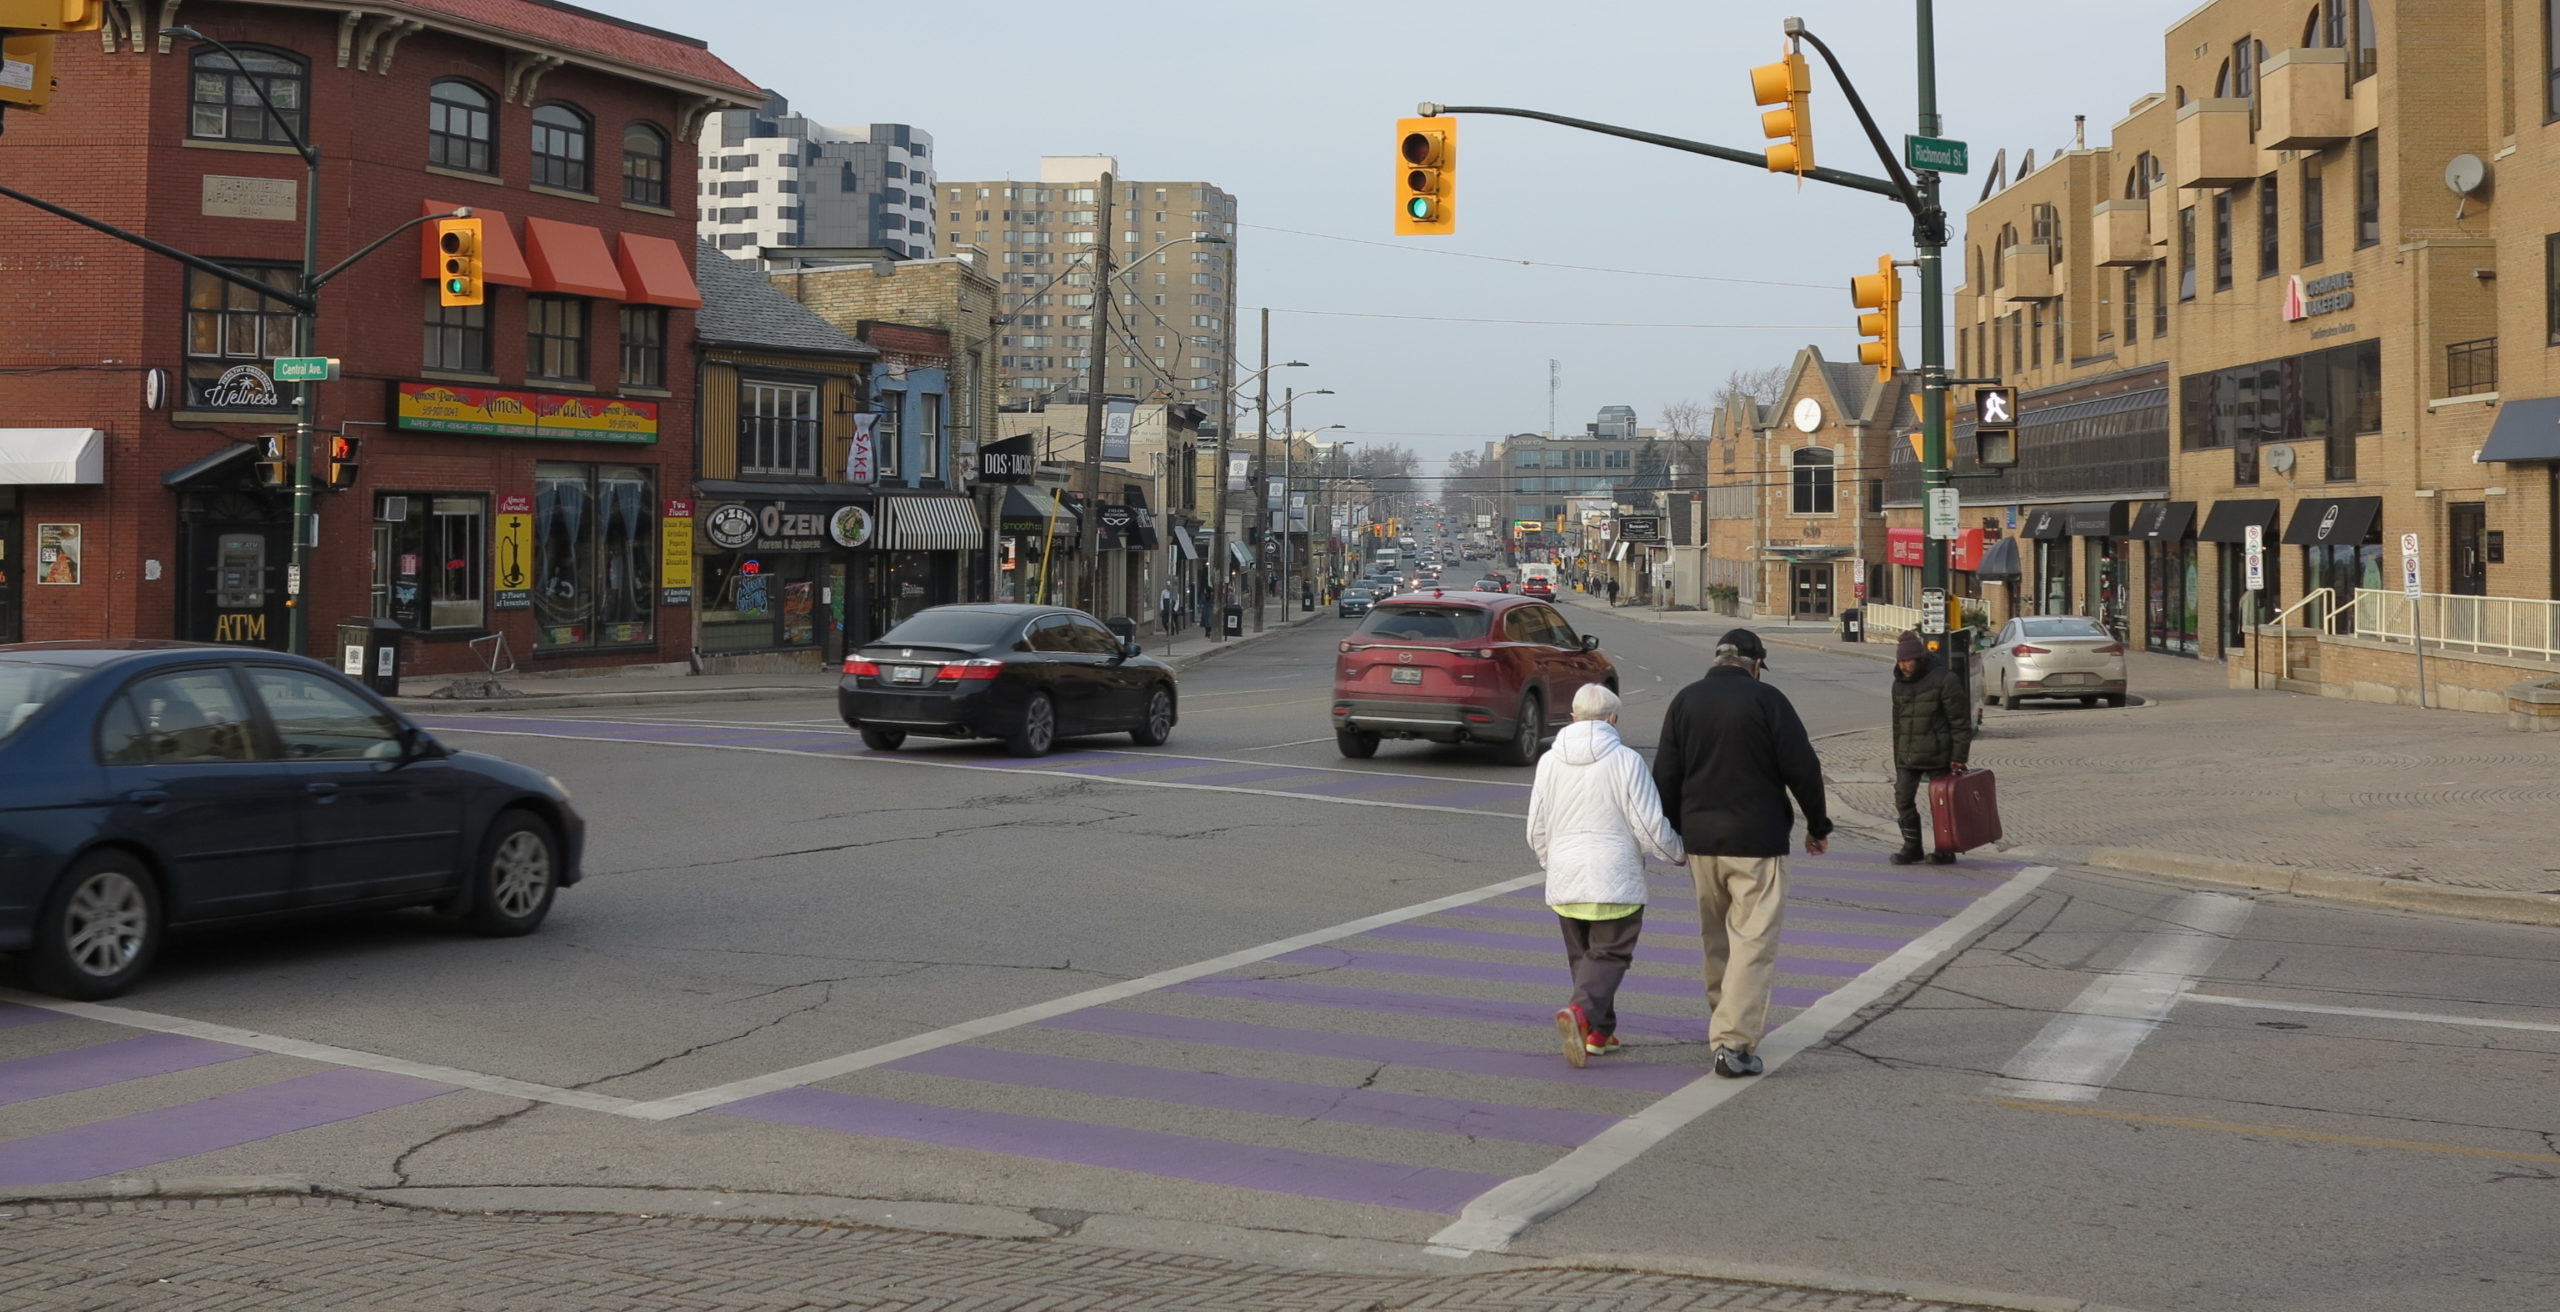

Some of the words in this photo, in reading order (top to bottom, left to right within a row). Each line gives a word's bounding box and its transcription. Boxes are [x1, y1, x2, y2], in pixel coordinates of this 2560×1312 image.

[1915, 144, 1951, 165] Richmond
[282, 363, 307, 375] Central
[308, 363, 323, 375] Ave.
[205, 385, 278, 406] Wellness
[477, 391, 525, 419] Almost
[537, 394, 593, 419] Paradise
[855, 431, 870, 480] SAKE
[985, 453, 1007, 475] DOS
[1011, 454, 1032, 475] TACOS
[668, 509, 689, 517] Floors
[671, 501, 686, 509] Two
[715, 508, 752, 526] O'ZEN
[1003, 520, 1034, 530] smooth
[757, 539, 782, 549] Korean
[790, 540, 821, 551] Japanese
[215, 613, 266, 641] ATM
